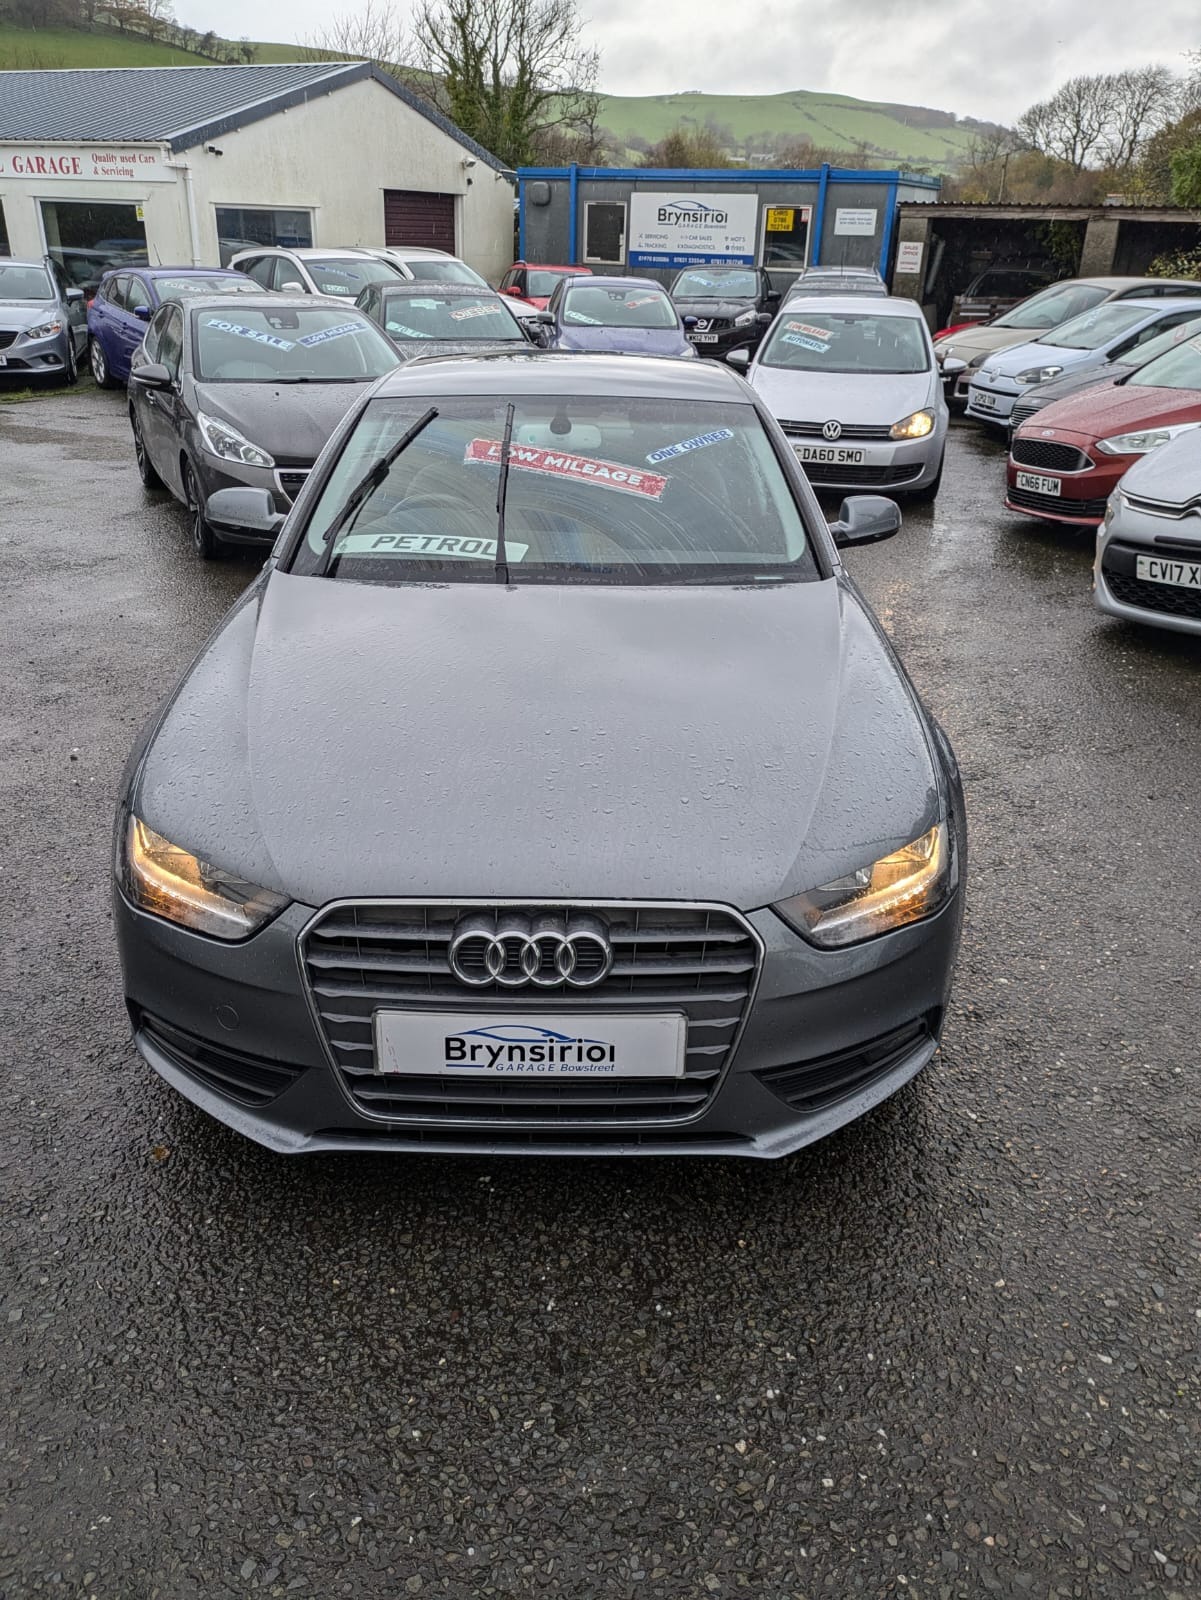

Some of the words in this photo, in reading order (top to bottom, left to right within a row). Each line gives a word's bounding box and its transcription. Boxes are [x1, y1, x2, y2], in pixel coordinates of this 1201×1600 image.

[12, 155, 83, 175] GARAGE
[91, 152, 117, 165] Quality
[120, 153, 136, 164] used
[139, 153, 155, 164] Cars
[93, 167, 99, 175] &
[101, 167, 134, 178] Servicing
[657, 207, 728, 226] Brynsiriol
[453, 304, 500, 320] DIESEL
[207, 318, 242, 334] FOR
[241, 325, 292, 349] SALE
[787, 335, 826, 350] AUTOMATIC
[650, 443, 679, 463] ONE
[681, 429, 730, 451] OWNER
[802, 447, 834, 461] DA60
[837, 449, 863, 462] SMO
[488, 443, 544, 462] LOW
[544, 453, 642, 486] MILEAGE
[1020, 475, 1040, 490] CN66
[1041, 479, 1060, 493] FUM
[371, 534, 498, 558] PETROL
[1149, 561, 1184, 583] CV17
[1188, 566, 1201, 585] X
[444, 1037, 615, 1068] Brynsiriol
[496, 1063, 556, 1072] GARAGE
[560, 1063, 615, 1072] Bowstreet
